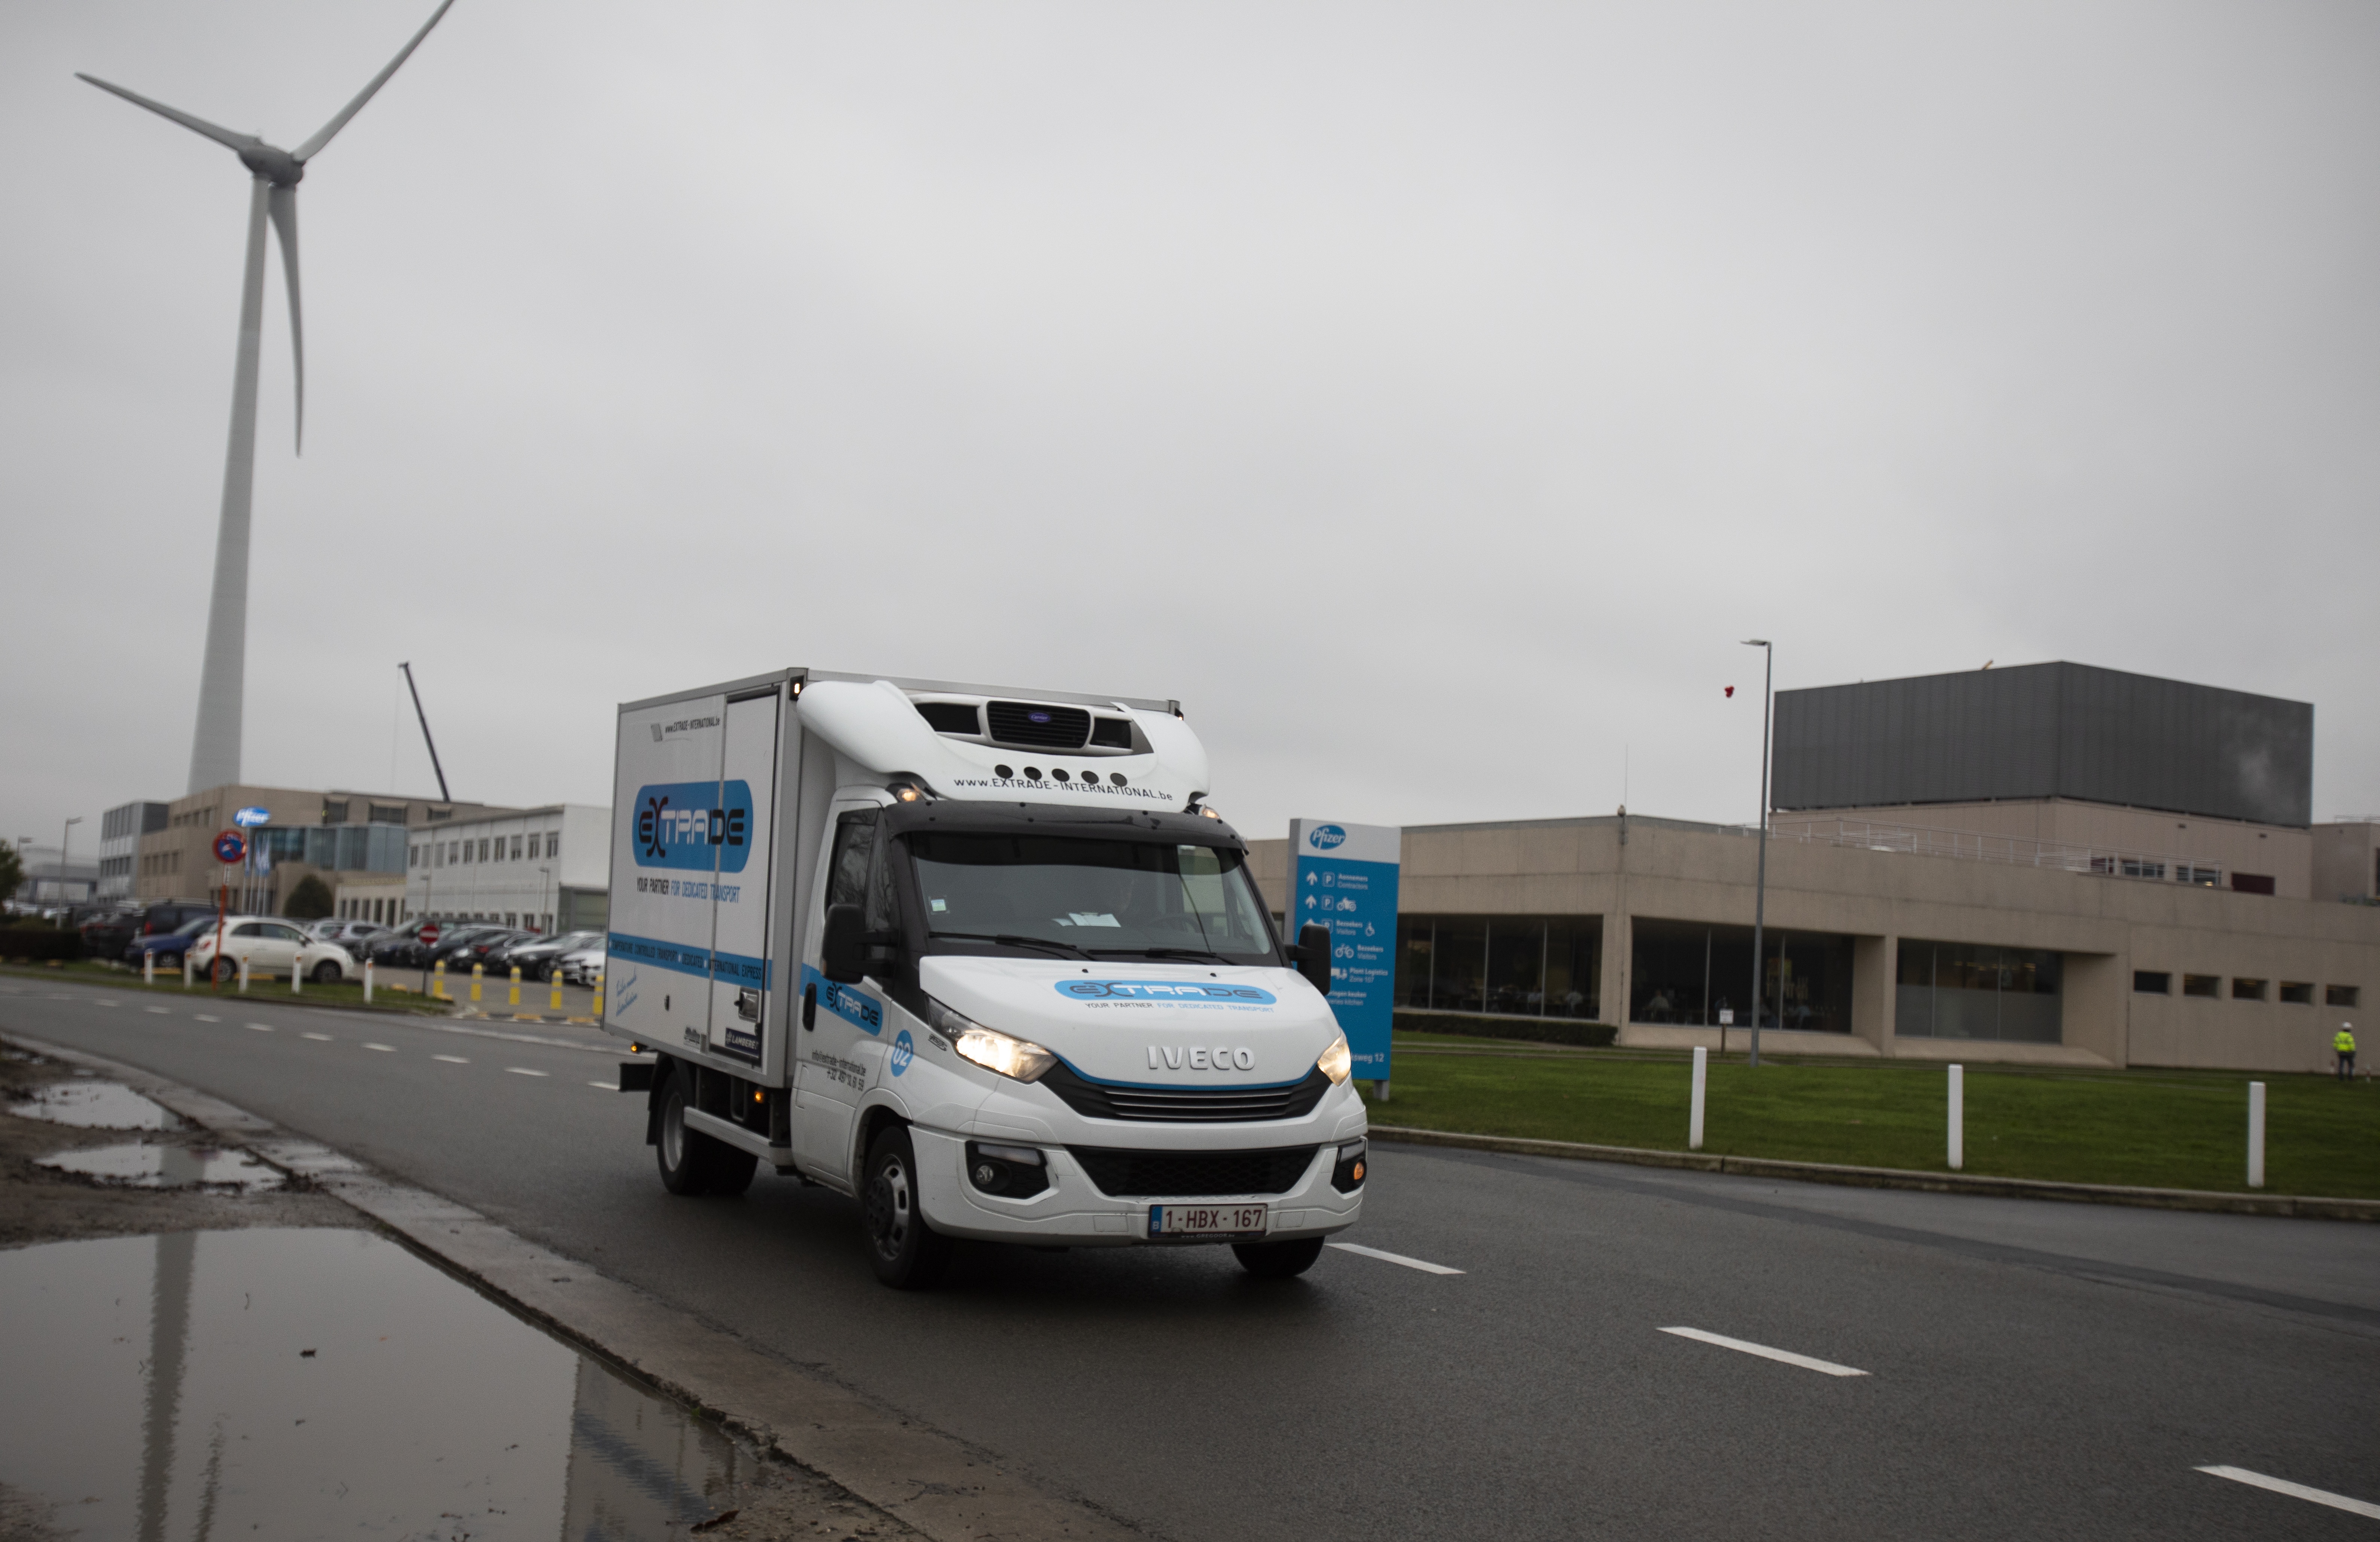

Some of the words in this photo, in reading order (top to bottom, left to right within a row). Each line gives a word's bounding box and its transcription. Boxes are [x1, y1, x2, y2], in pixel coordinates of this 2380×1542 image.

[954, 778, 1173, 801] www.EXTRADE-INTERNATIONAL.be
[1312, 827, 1345, 849] Pfizer
[637, 877, 648, 892] YOUR
[649, 878, 669, 895] PARTNER
[671, 880, 680, 896] FOR
[682, 881, 707, 899] DEDICATED
[710, 883, 740, 903] TRANSPORT
[682, 953, 703, 969] DEDICATED
[742, 964, 761, 980] EXPRESS
[1227, 1005, 1275, 1013] TRANSPORT
[893, 1041, 911, 1067] 02
[1147, 1046, 1255, 1070] IVECO
[1351, 1052, 1373, 1064] ksweg
[1374, 1052, 1384, 1062] 12
[1153, 1221, 1160, 1230] B
